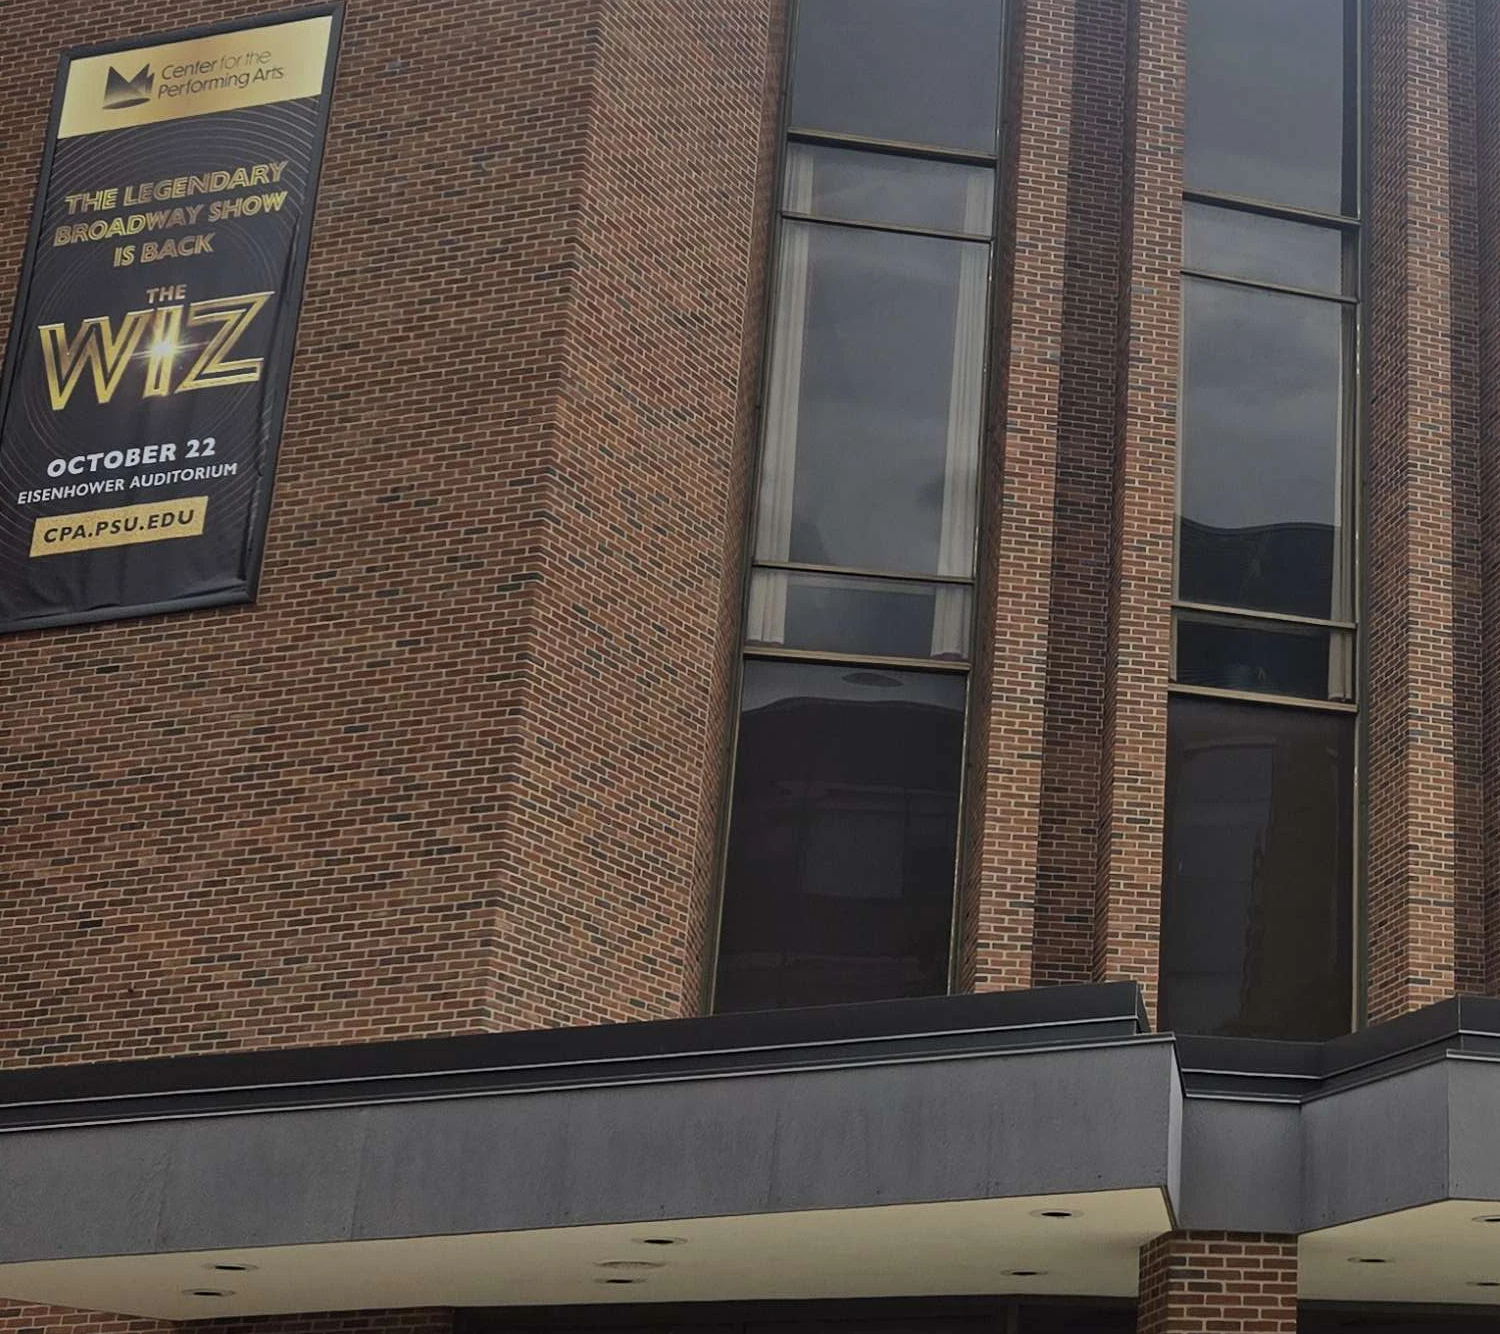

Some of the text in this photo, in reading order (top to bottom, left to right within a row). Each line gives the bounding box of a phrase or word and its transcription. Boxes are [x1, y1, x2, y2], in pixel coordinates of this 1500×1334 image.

[158, 66, 285, 99] Performing Arts
[161, 50, 272, 81] Center for the
[65, 161, 289, 214] THE LEGENDARY
[53, 191, 288, 247] BROADWAY SHOW
[113, 233, 216, 267] IS BACK
[146, 284, 187, 303] THE
[38, 291, 276, 411] WIZ
[47, 437, 216, 478] OCTOBER 22
[17, 462, 238, 505] EISENHOWER AUDITORIUM
[43, 509, 195, 544] CPA.PSU.EDU
